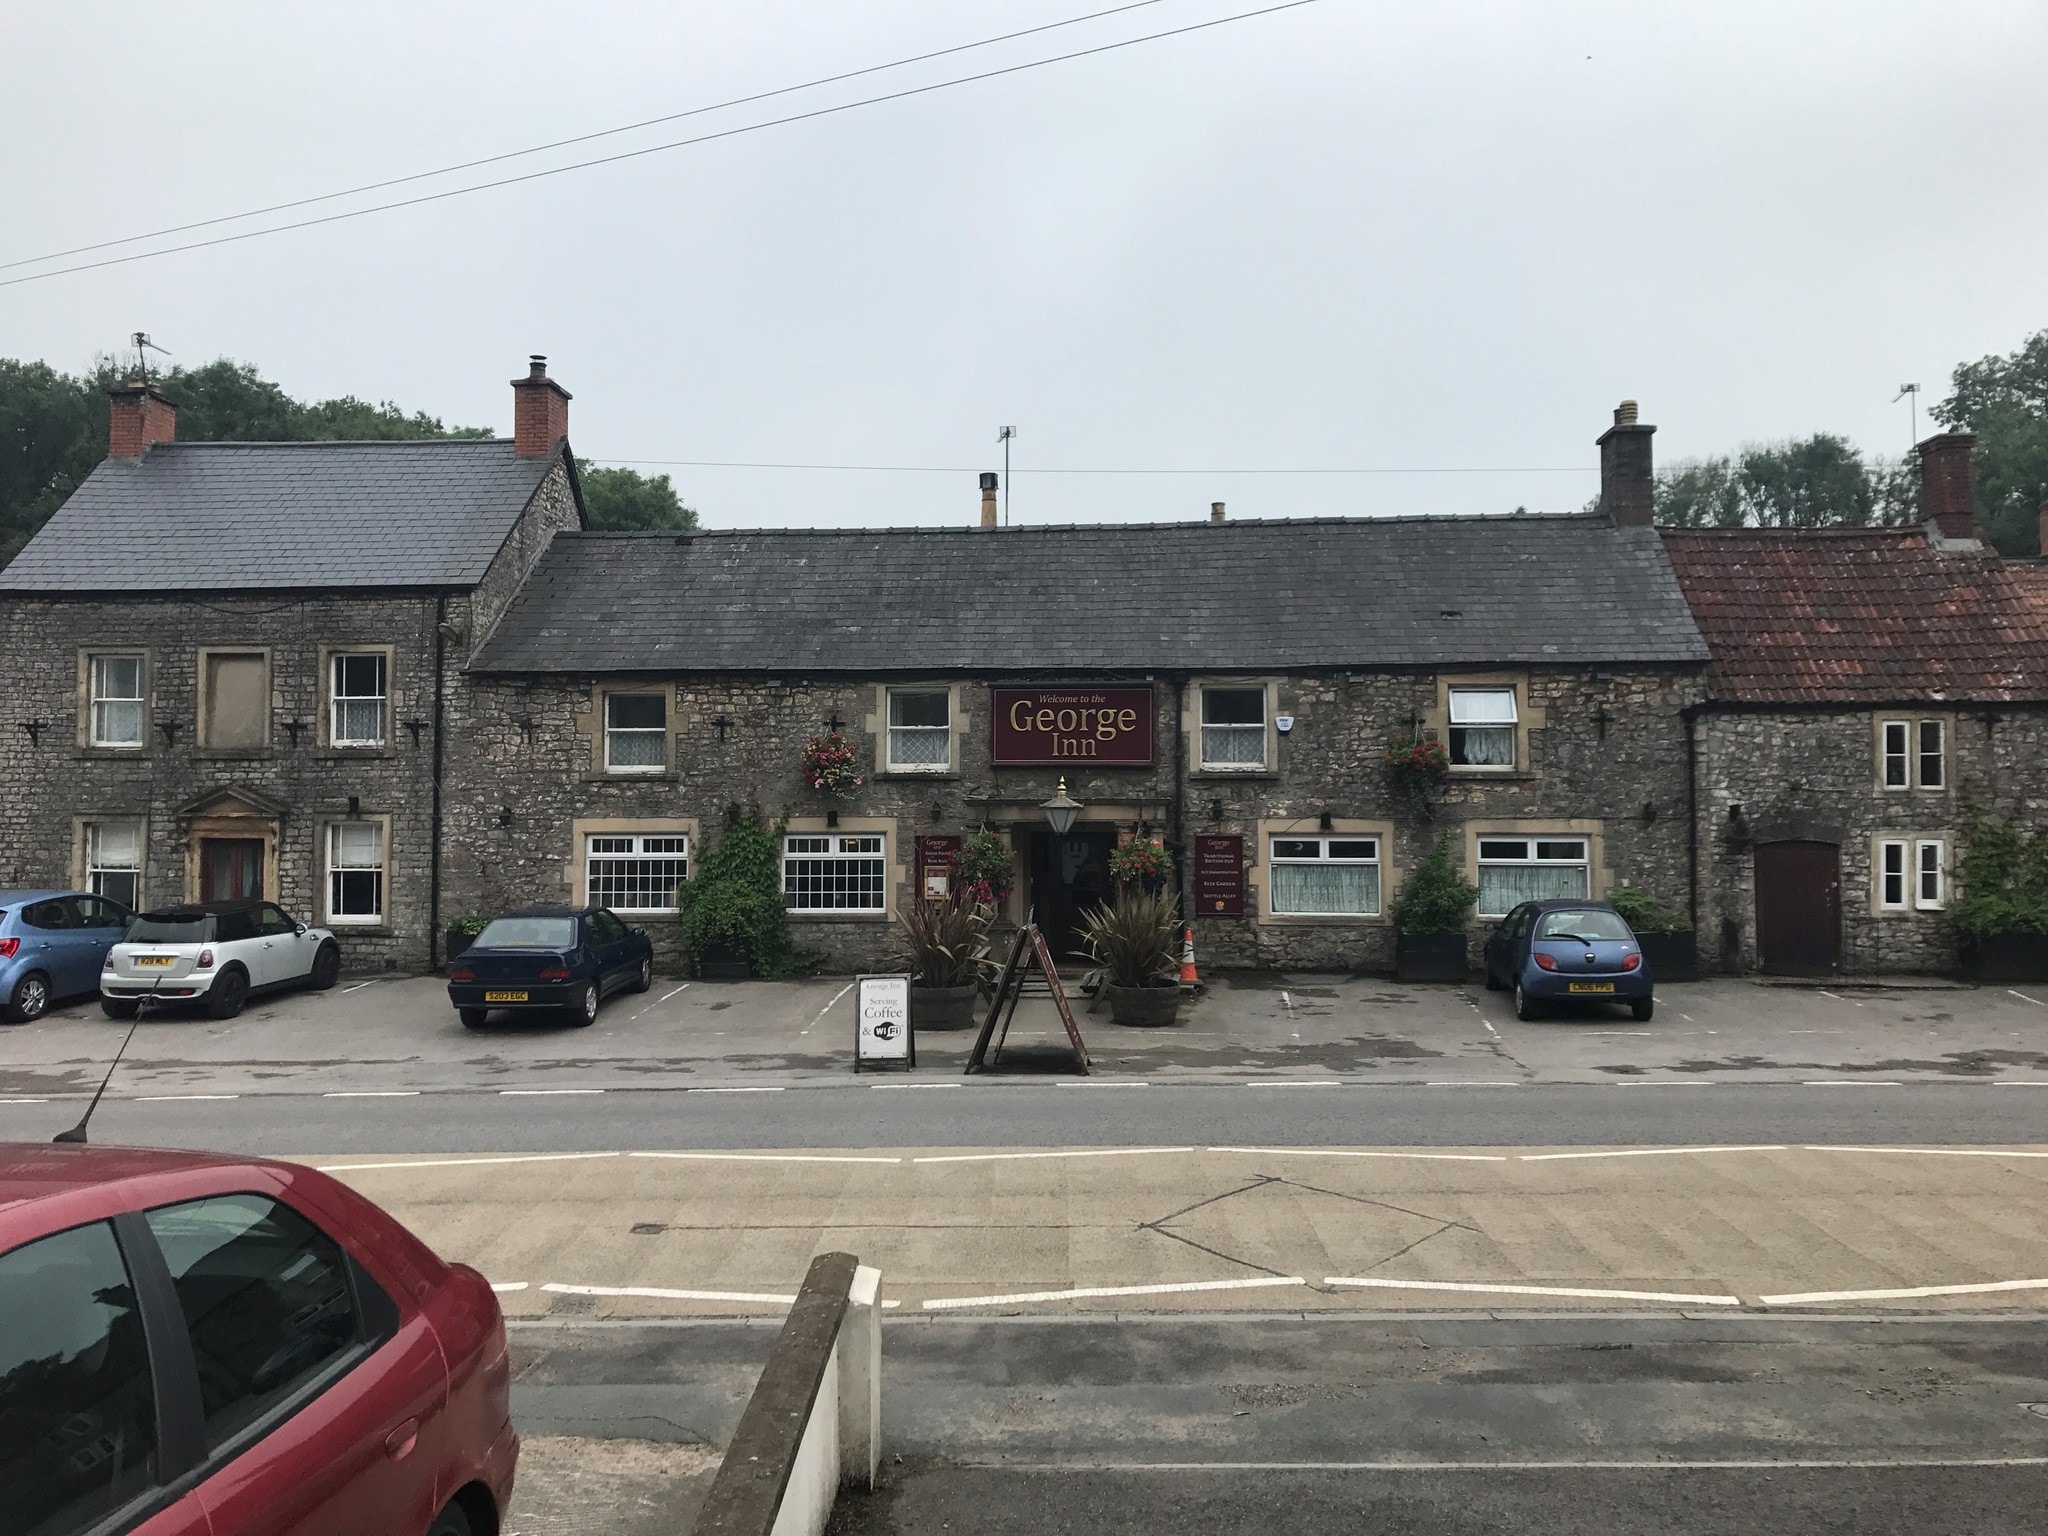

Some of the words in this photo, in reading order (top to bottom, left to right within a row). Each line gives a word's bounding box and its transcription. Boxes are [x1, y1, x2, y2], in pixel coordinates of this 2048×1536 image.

[1039, 694, 1078, 703] Welcome
[1080, 694, 1089, 703] to
[1091, 694, 1106, 703] the
[1010, 700, 1137, 741] George
[1051, 732, 1097, 756] Inn
[489, 992, 509, 1000] S203
[510, 992, 526, 1000] EGC
[869, 998, 898, 1006] Serving
[864, 1006, 903, 1019] Coffee
[862, 1027, 872, 1036] &
